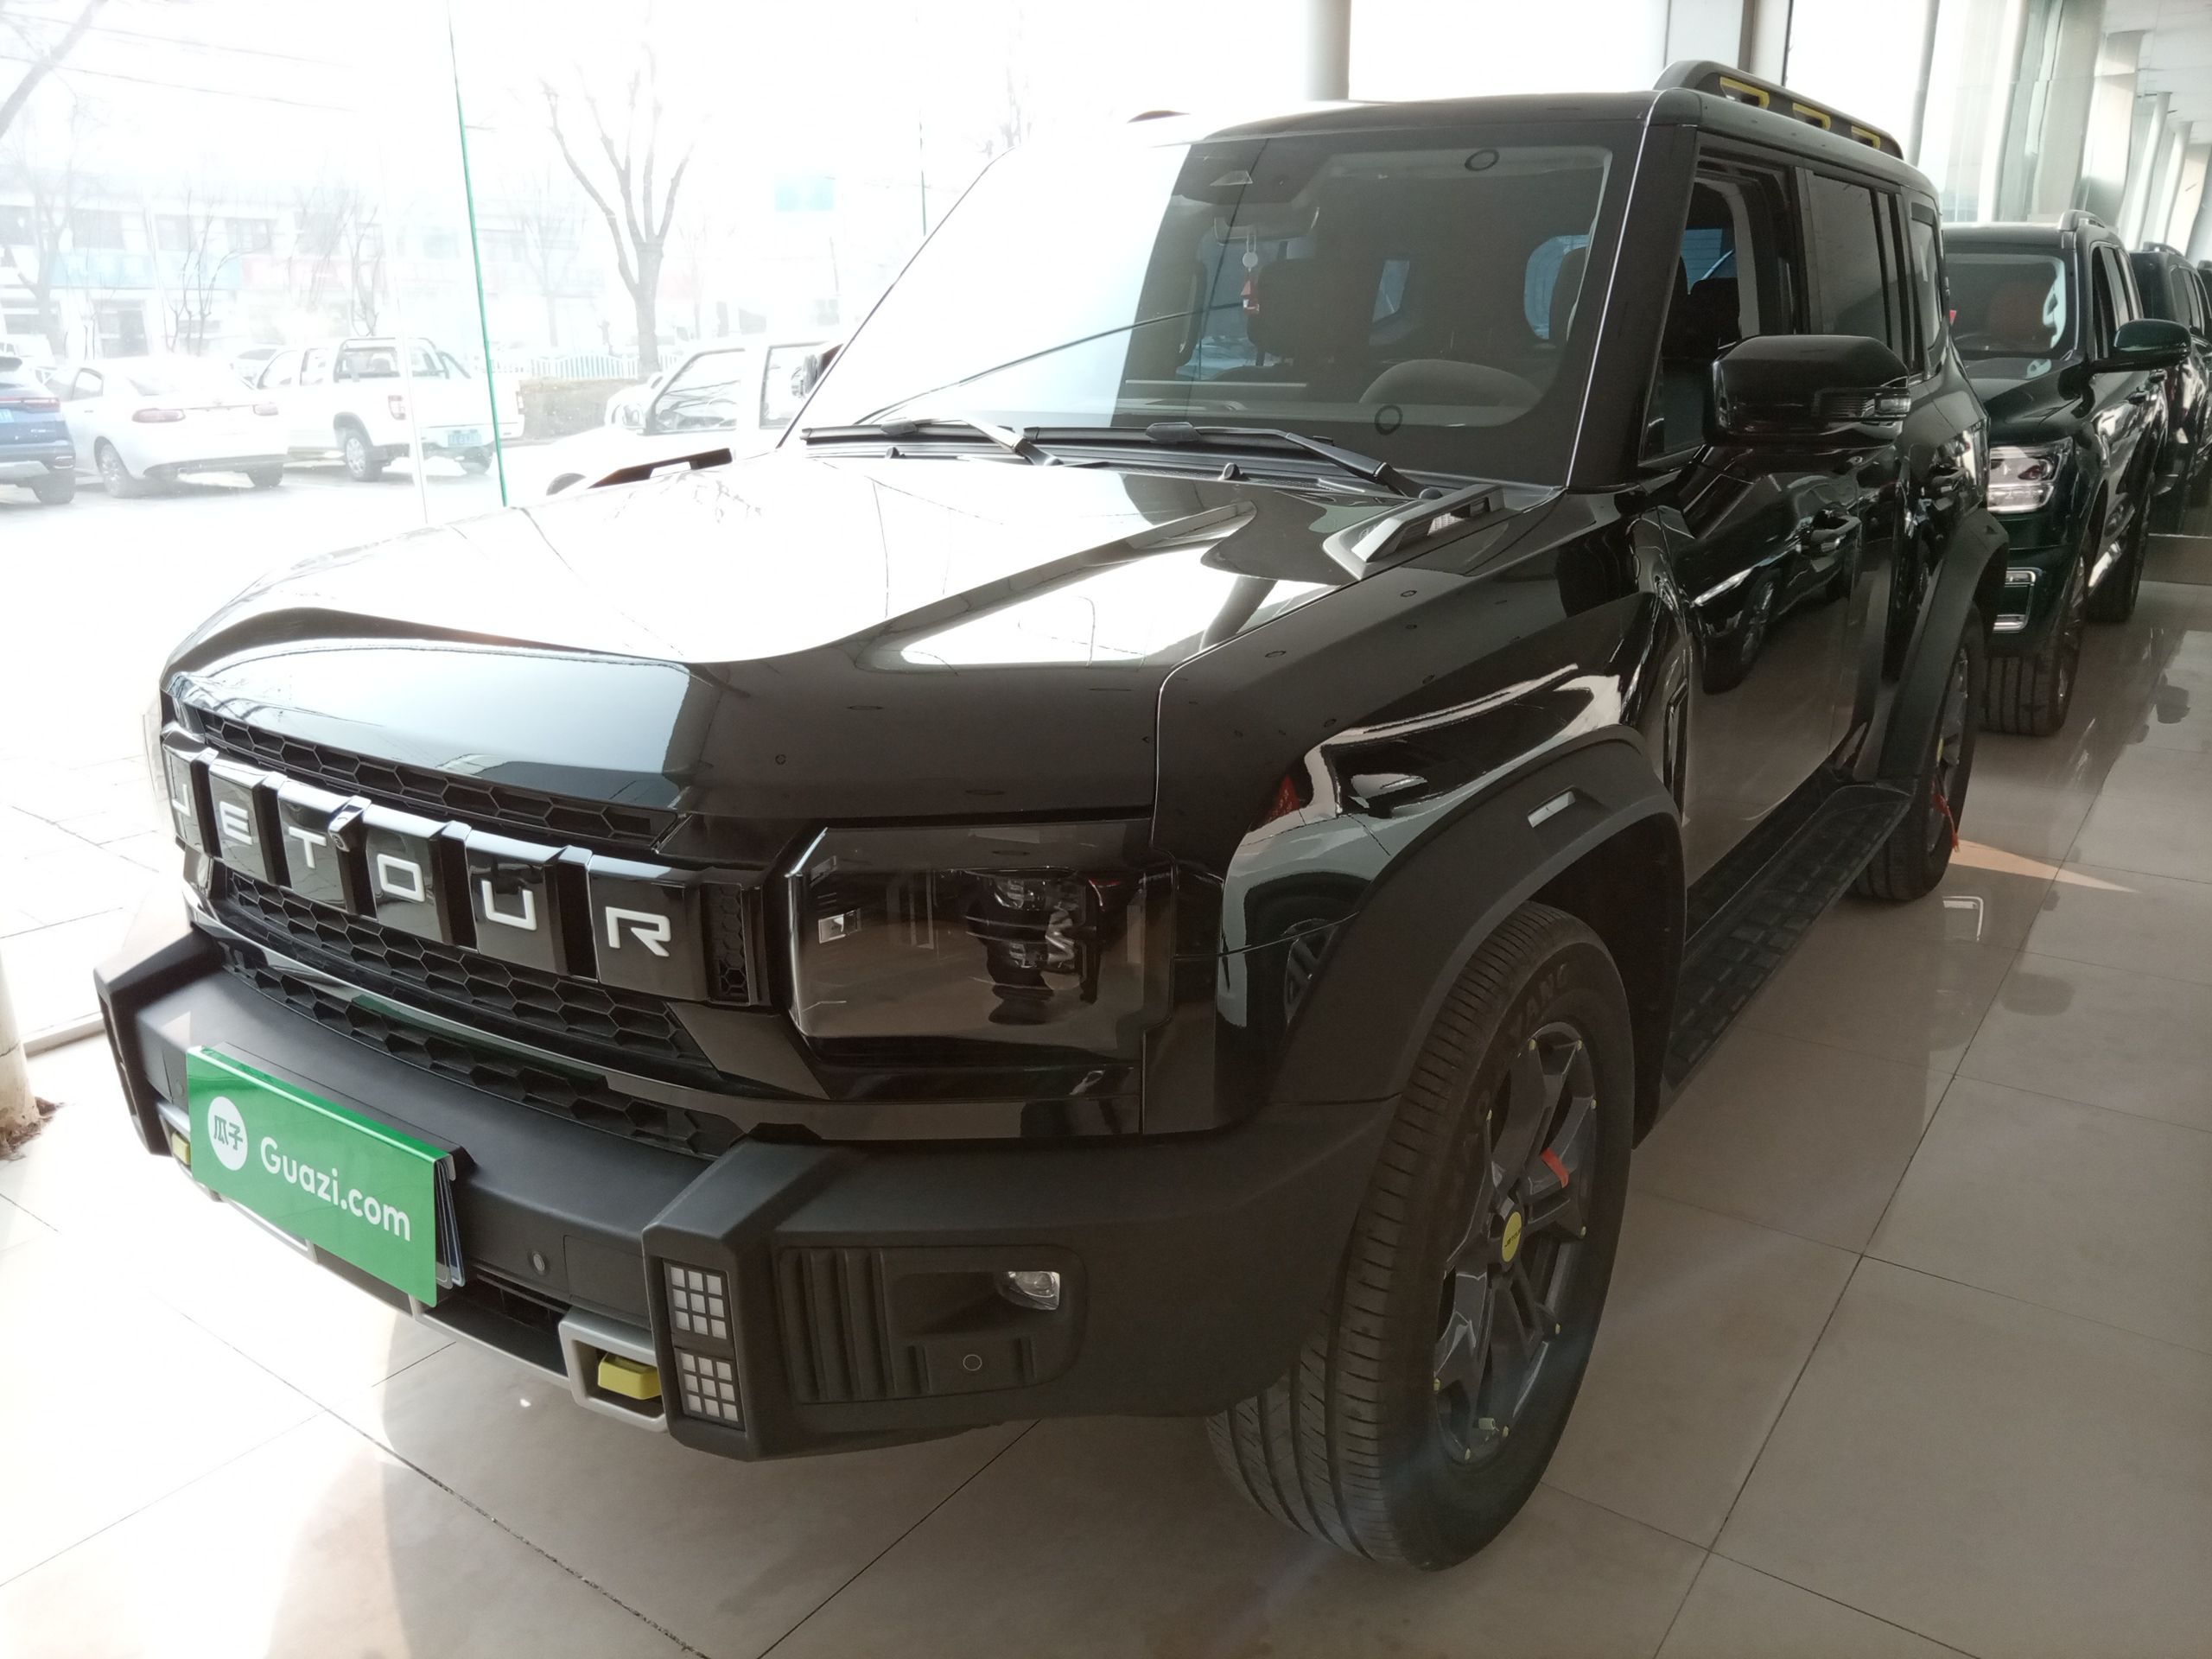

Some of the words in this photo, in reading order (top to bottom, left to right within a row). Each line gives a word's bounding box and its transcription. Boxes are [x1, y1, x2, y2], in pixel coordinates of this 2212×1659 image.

[172, 784, 671, 957] JETOUR
[213, 1115, 243, 1151] 瓜子
[260, 1136, 410, 1242] Guazi.com
